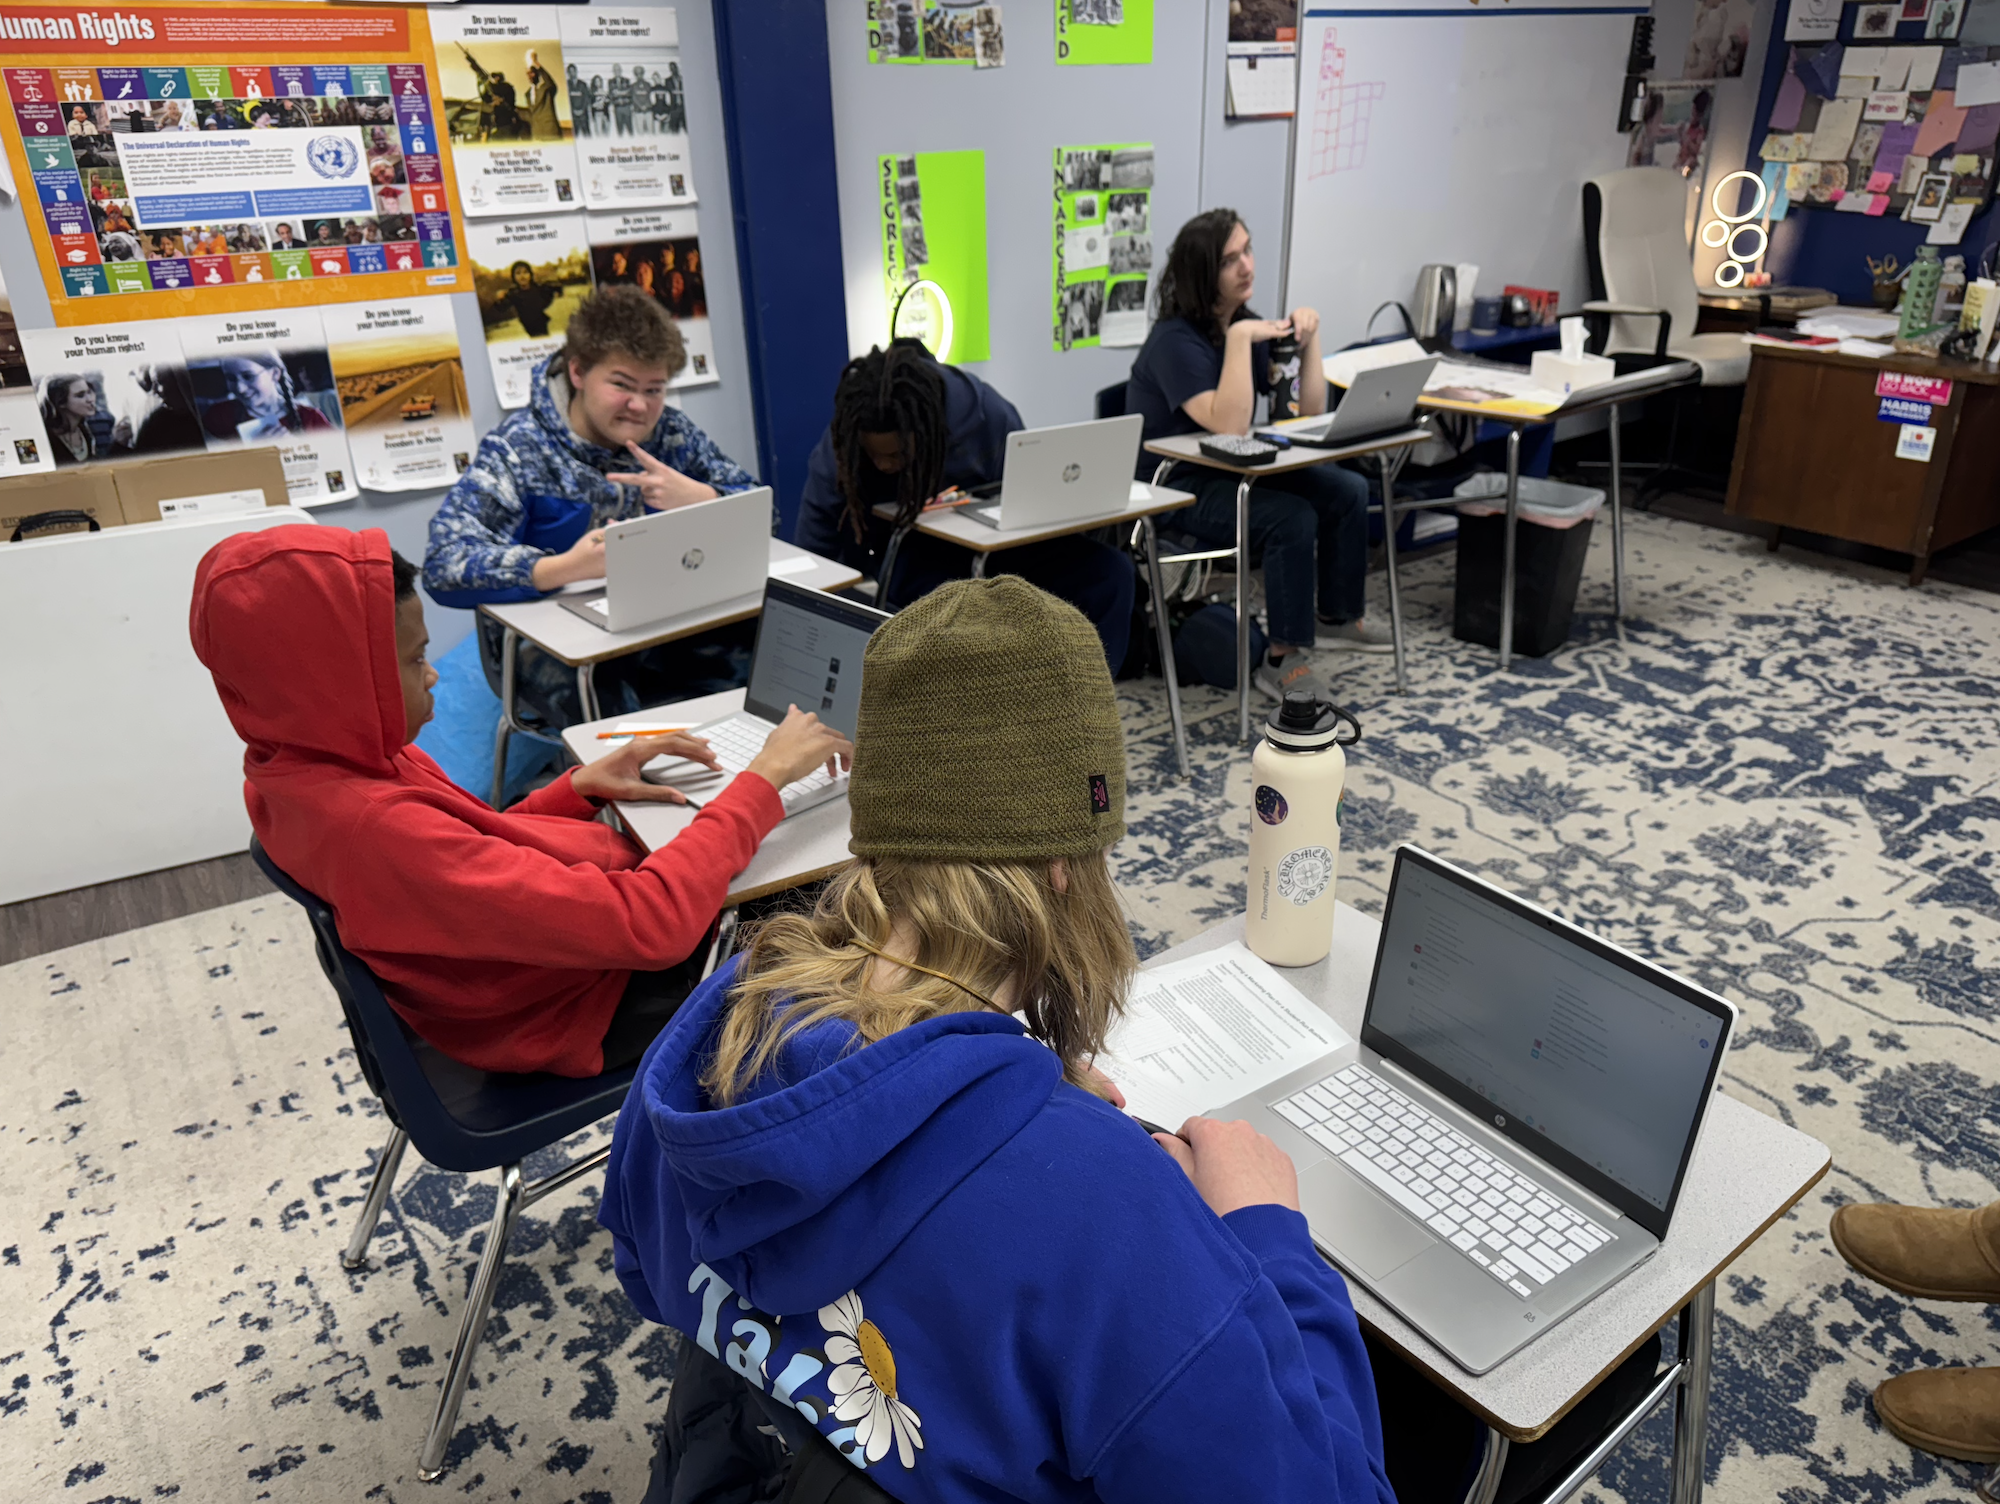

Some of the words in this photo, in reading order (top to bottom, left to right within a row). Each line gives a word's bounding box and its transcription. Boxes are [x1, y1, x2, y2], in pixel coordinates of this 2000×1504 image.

[472, 16, 482, 25] Do
[484, 17, 496, 26] you
[499, 15, 517, 24] know
[598, 17, 607, 26] Do
[609, 18, 620, 27] you
[622, 17, 639, 26] know
[77, 12, 155, 46] Rights
[463, 28, 479, 37] your
[481, 26, 505, 35] human
[507, 26, 530, 36] rights?
[590, 28, 604, 37] your
[606, 27, 628, 36] human
[630, 27, 650, 37] rights?
[231, 140, 250, 148] Rights
[365, 310, 374, 319] Do
[377, 311, 390, 319] you
[392, 308, 411, 316] know
[226, 323, 237, 332] Do
[239, 323, 254, 332] you
[255, 321, 276, 329] know
[357, 322, 372, 331] your
[374, 320, 399, 328] human
[401, 315, 424, 326] rights?
[74, 336, 86, 346] Do
[89, 337, 104, 346] you
[106, 334, 130, 342] know
[217, 335, 235, 344] your
[237, 332, 264, 341] human
[266, 328, 290, 339] rights?
[65, 349, 83, 358] your
[86, 346, 116, 355] human
[118, 342, 146, 353] rights?
[1881, 398, 1932, 416] HARRIS
